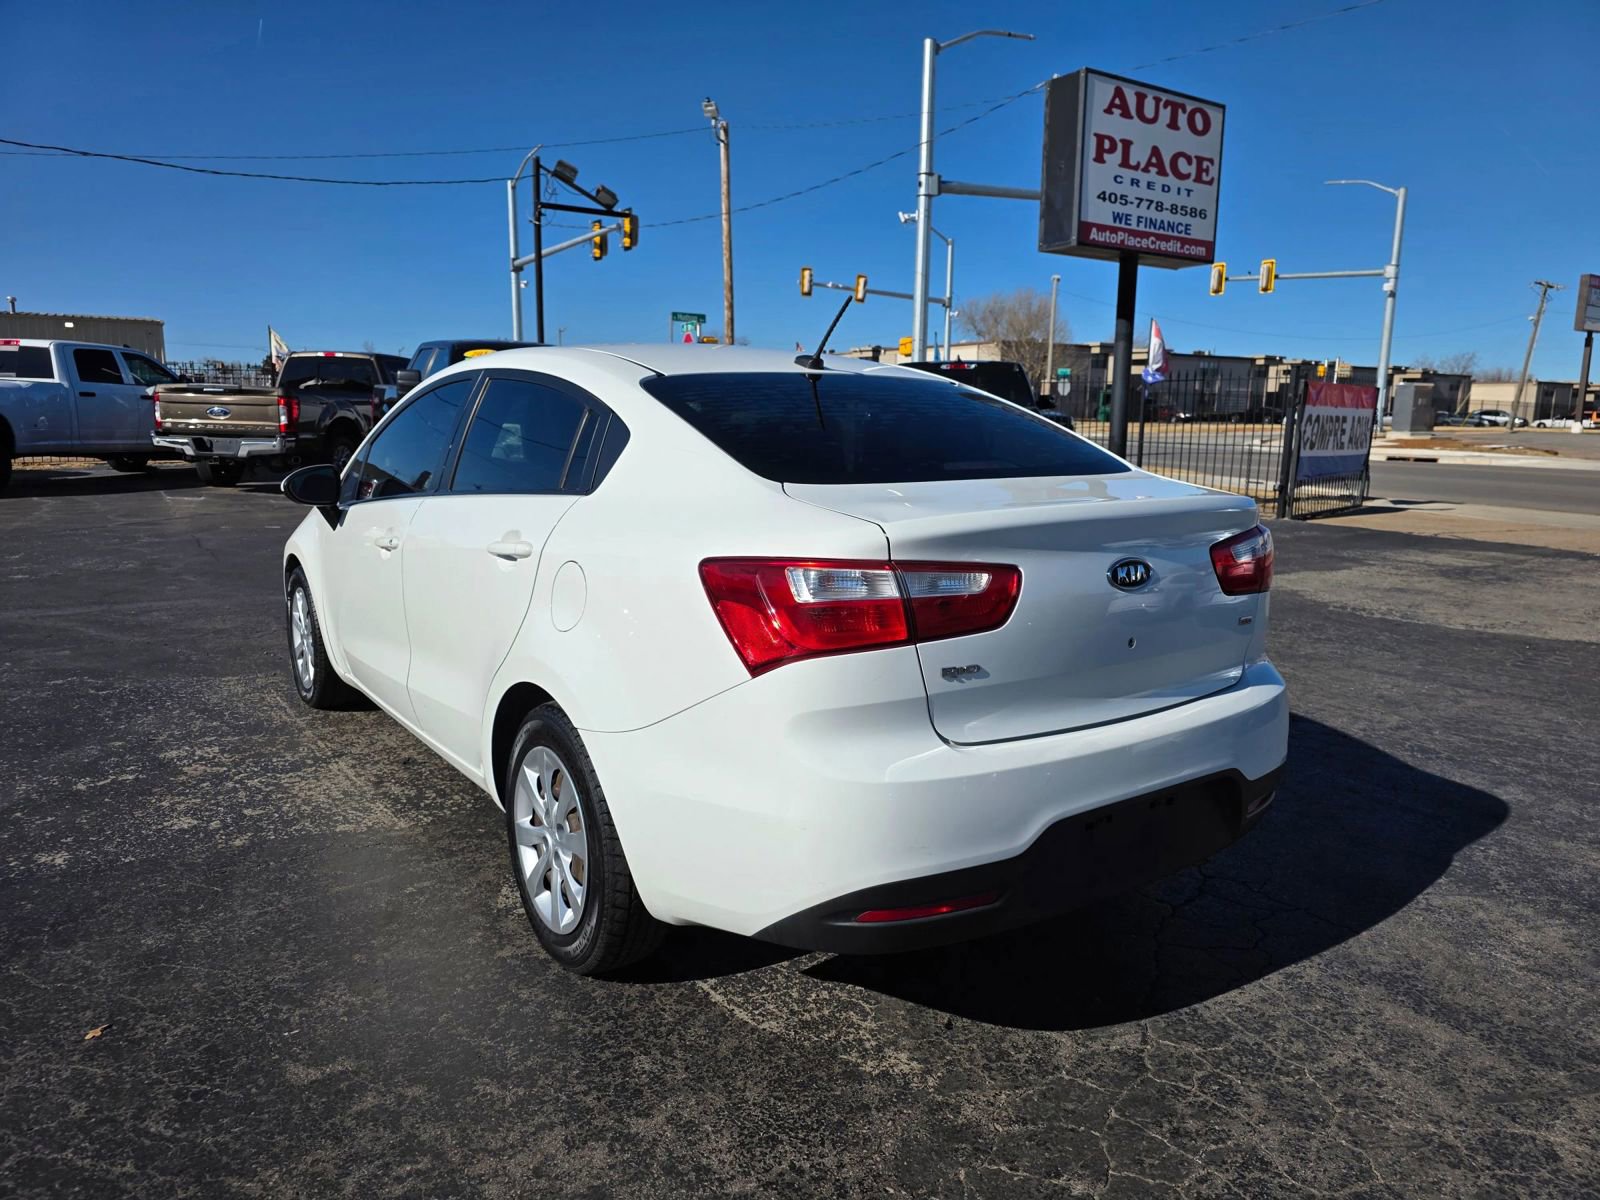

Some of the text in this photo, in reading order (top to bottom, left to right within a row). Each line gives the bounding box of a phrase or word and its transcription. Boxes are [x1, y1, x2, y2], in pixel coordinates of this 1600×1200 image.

[1103, 85, 1212, 137] AUTO
[1092, 132, 1215, 186] PLACE
[1113, 174, 1194, 198] CREDIT
[1096, 190, 1208, 220] 405-778-8586
[1112, 211, 1192, 236] WE FINANCE
[1089, 227, 1206, 257] AutoPlaceCredit.com
[1302, 413, 1347, 451] COMPRE
[1117, 564, 1148, 584] KIA
